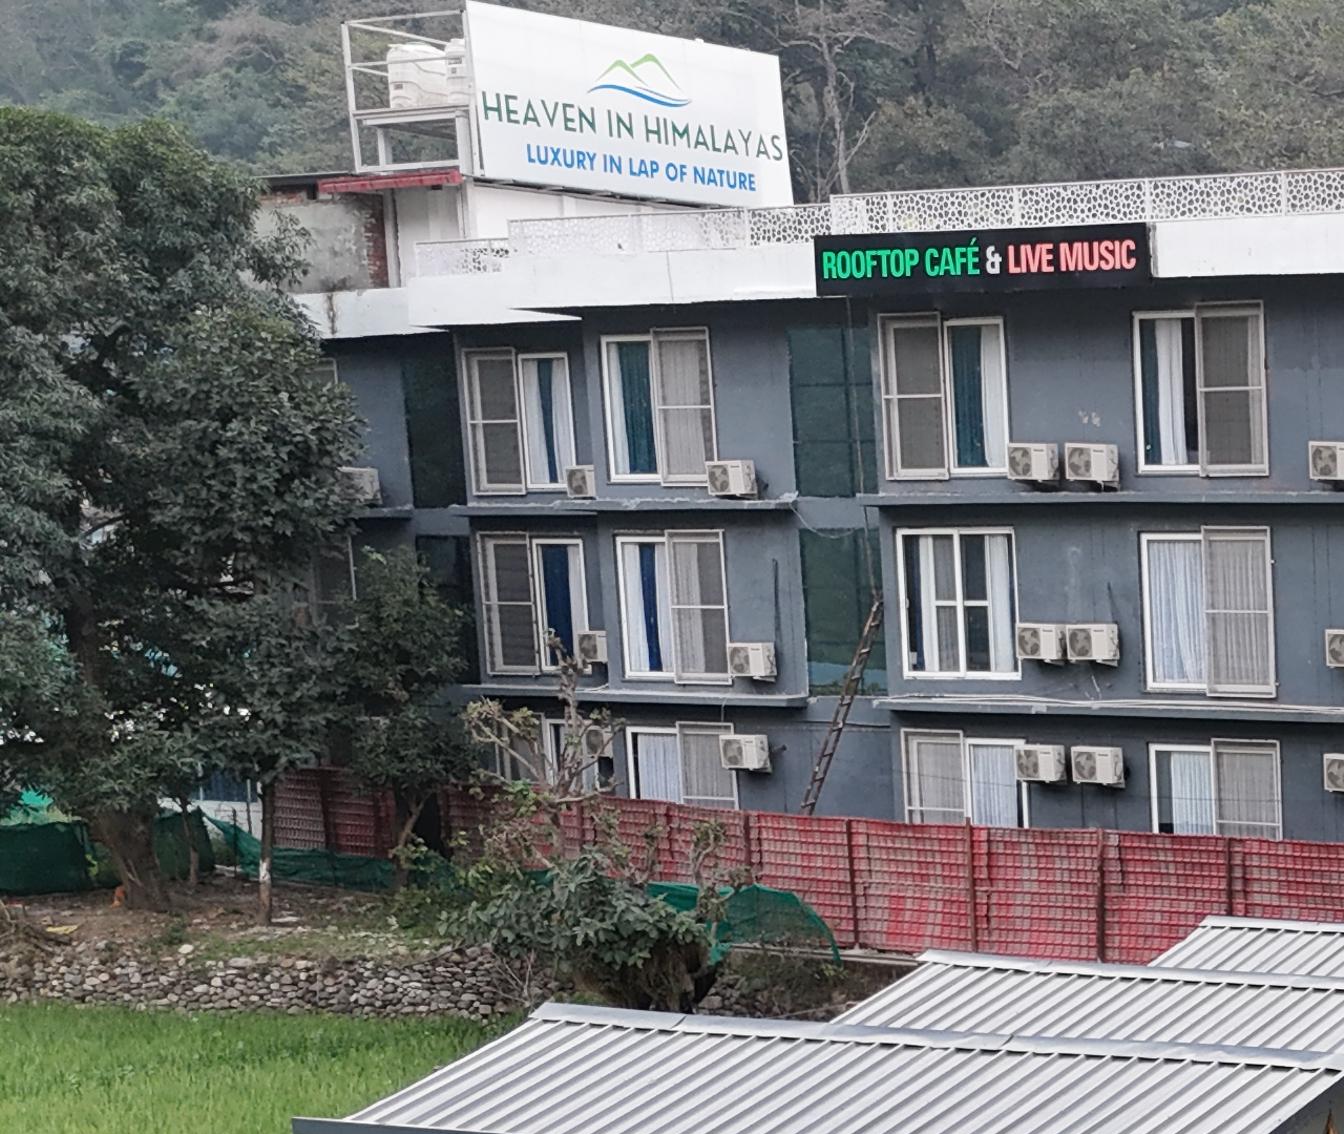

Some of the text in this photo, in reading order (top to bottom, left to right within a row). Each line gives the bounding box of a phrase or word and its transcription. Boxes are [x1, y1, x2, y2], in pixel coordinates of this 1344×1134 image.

[481, 90, 784, 161] HEAVEN IN HIMALAYAS
[526, 144, 756, 192] LUXURY IN LAP OF NATURE
[822, 237, 1136, 279] ROOFTOP CAFÉ & LIVE MUSIC
